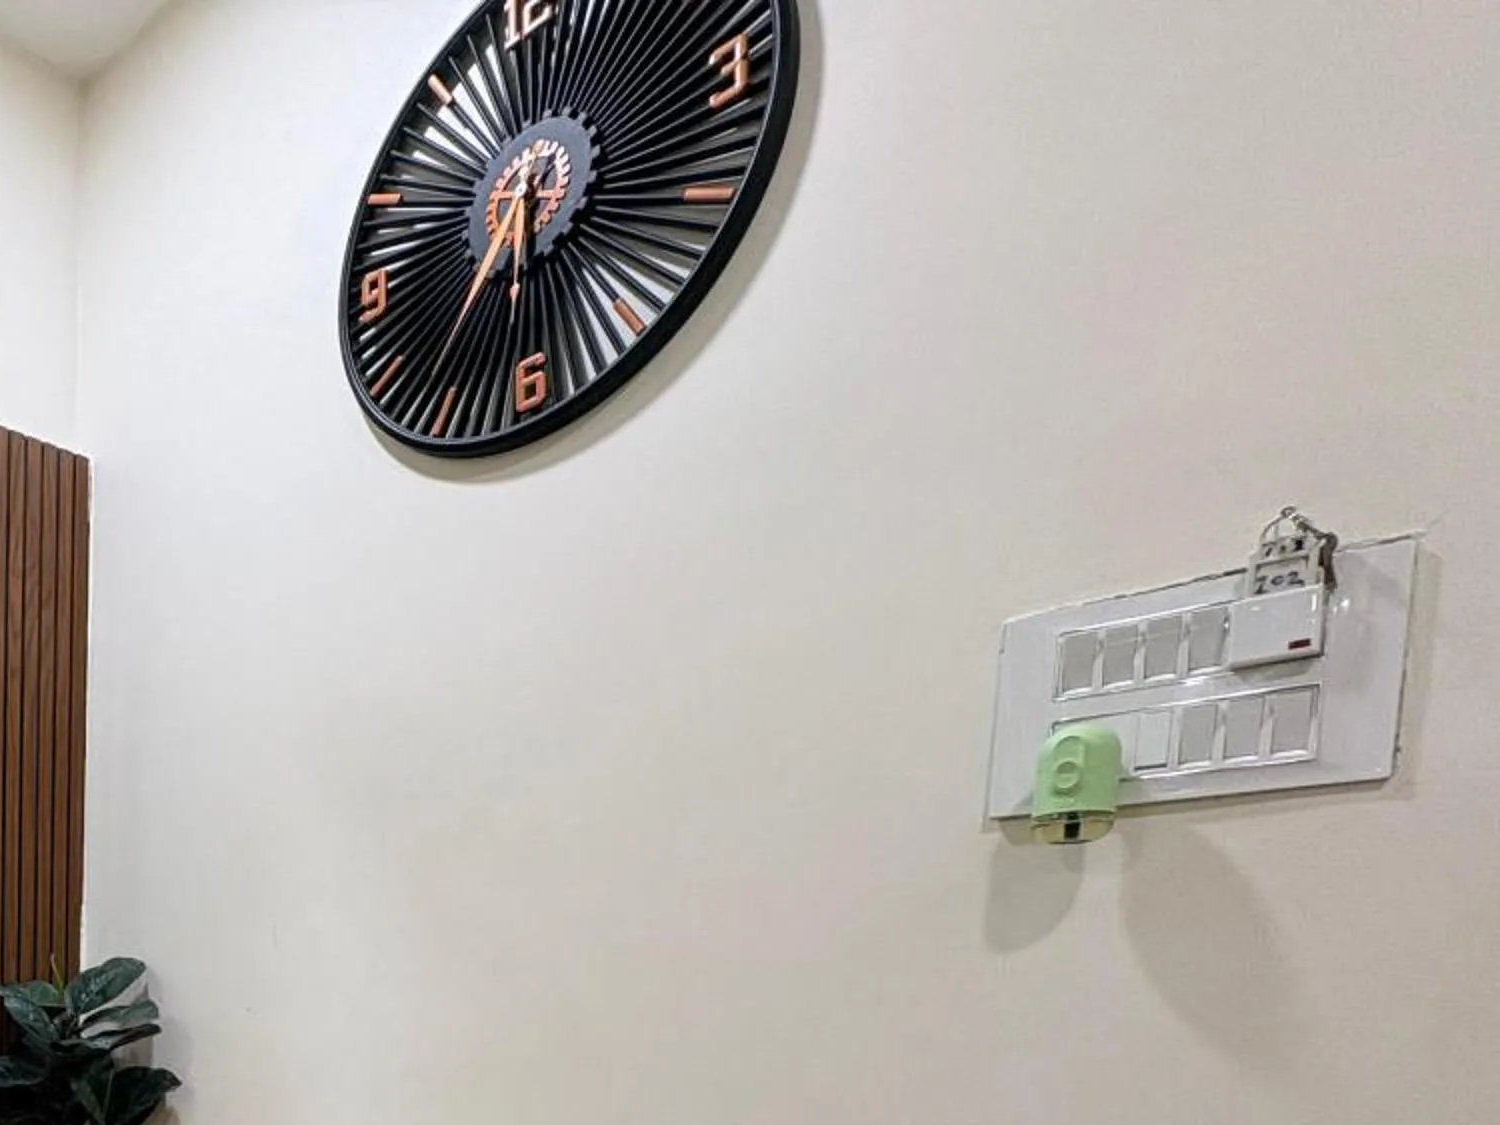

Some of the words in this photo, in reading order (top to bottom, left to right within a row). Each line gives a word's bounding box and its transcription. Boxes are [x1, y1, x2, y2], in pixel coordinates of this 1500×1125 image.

[709, 33, 749, 108] 3
[359, 269, 389, 323] 9
[515, 352, 547, 414] 6
